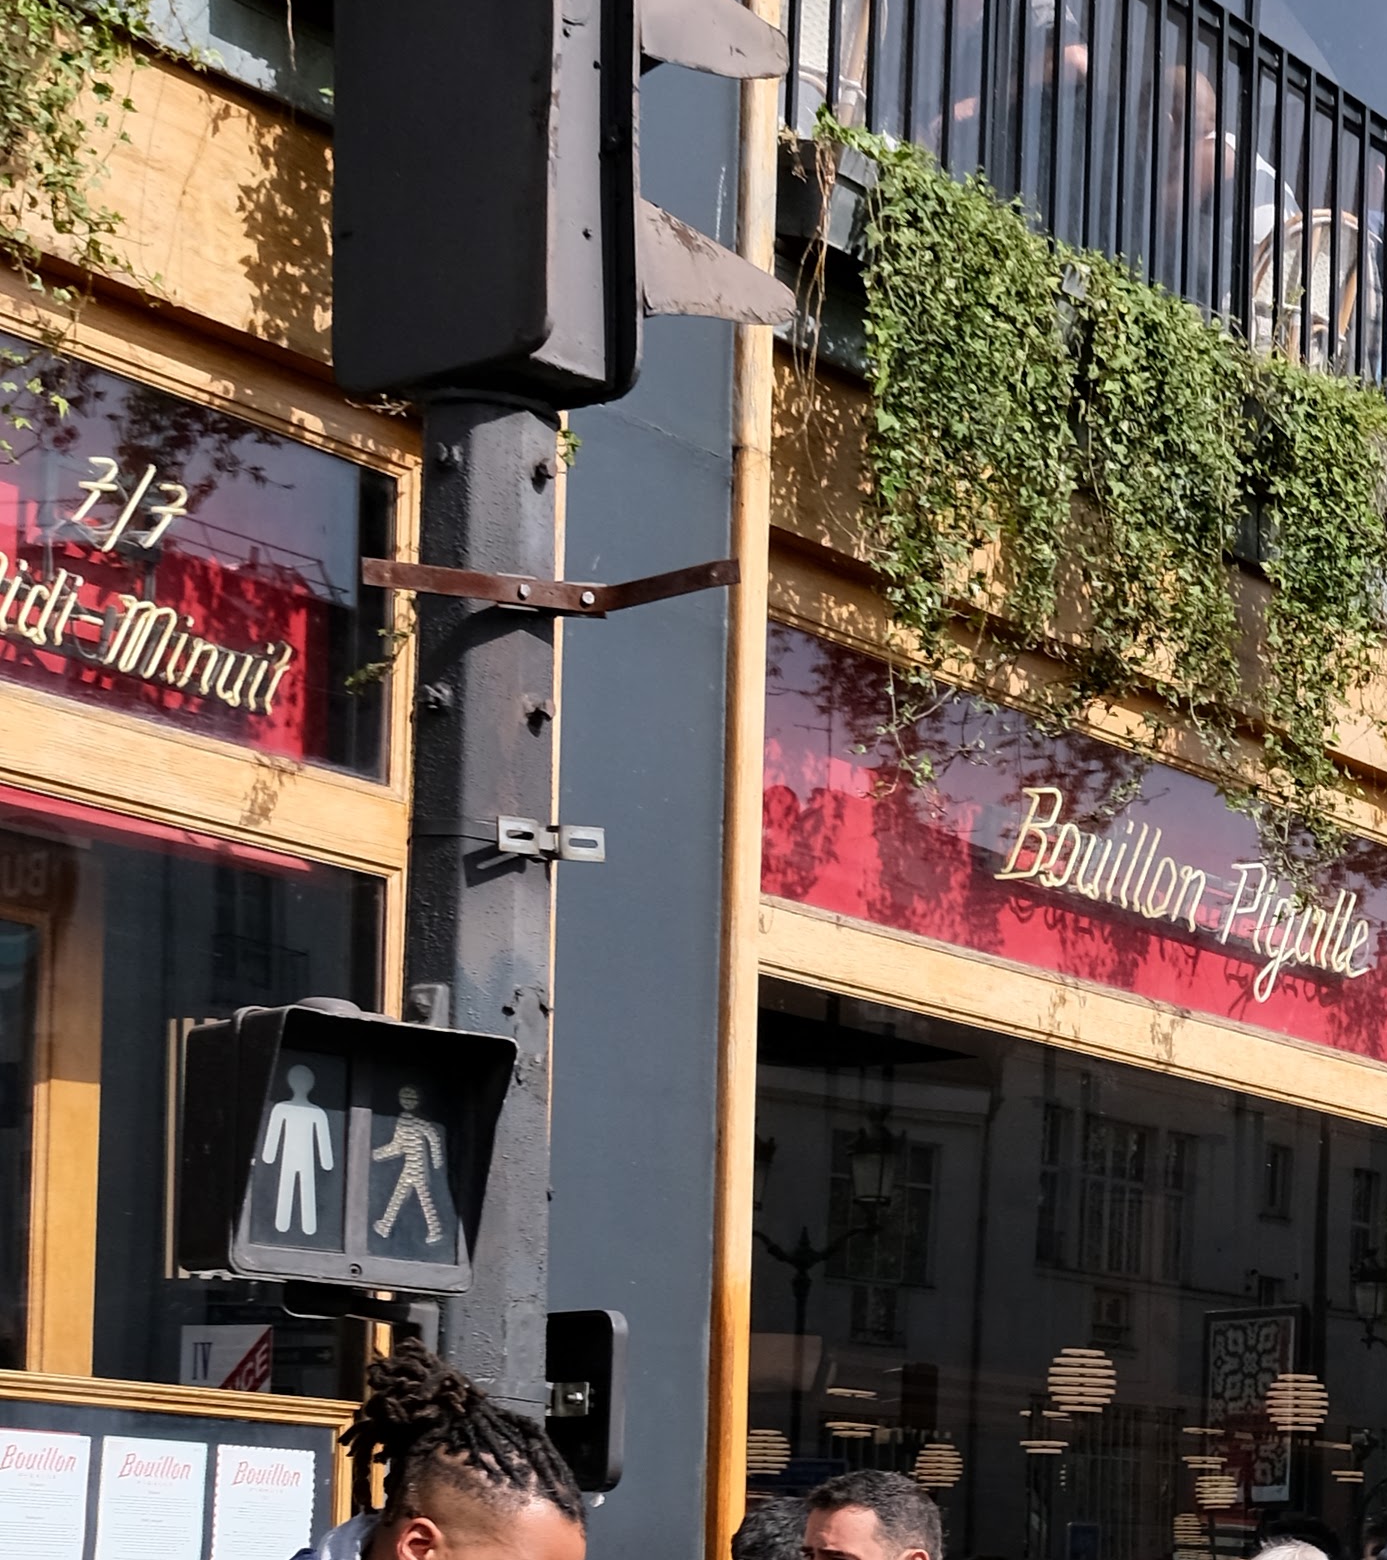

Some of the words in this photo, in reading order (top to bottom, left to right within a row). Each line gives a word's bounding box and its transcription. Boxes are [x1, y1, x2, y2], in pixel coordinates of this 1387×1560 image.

[72, 456, 188, 552] 7/7
[994, 786, 1207, 933] Bouillon
[1221, 861, 1371, 1004] Pigalle
[0, 1444, 77, 1472] Bouillon
[117, 1452, 192, 1480] Bouillon
[231, 1461, 301, 1487] Bouillon
